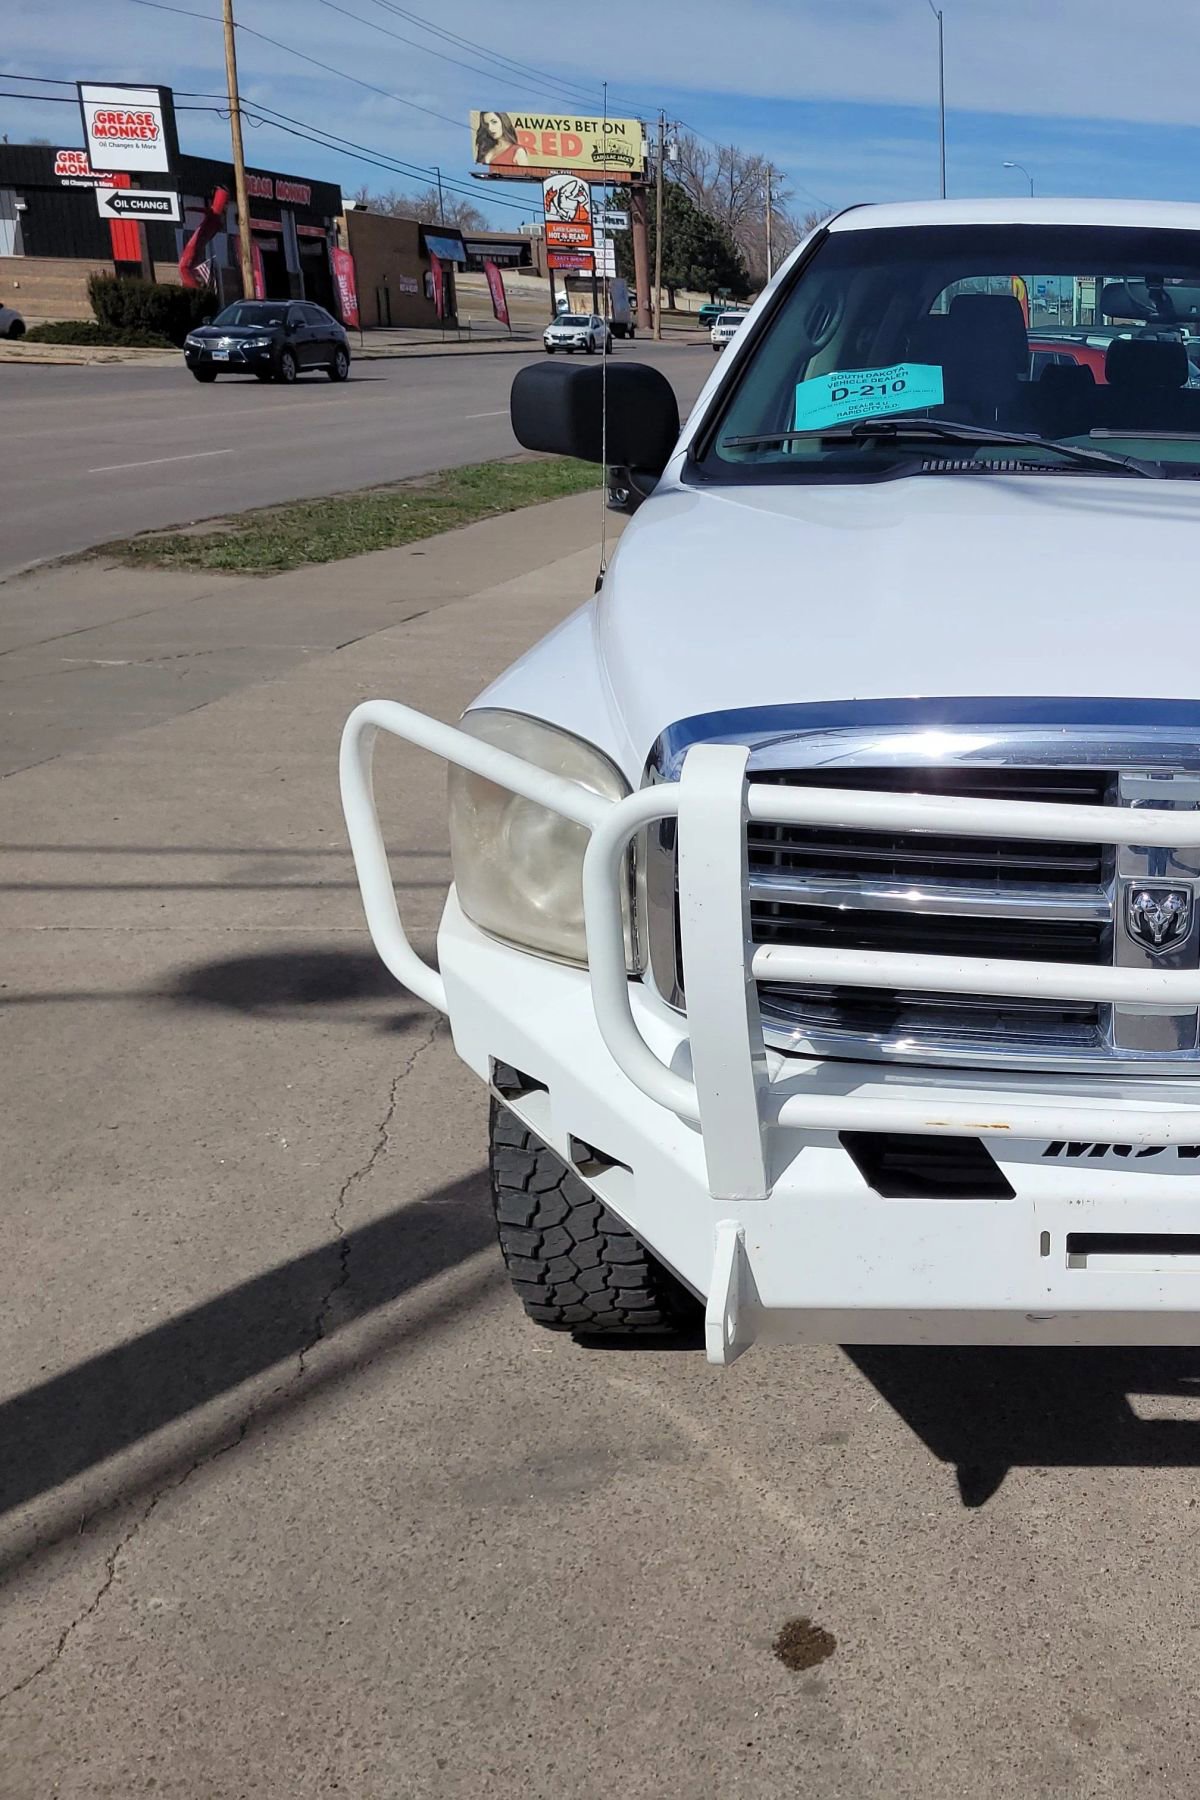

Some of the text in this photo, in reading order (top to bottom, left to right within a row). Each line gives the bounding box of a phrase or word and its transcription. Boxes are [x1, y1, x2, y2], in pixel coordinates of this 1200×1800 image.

[96, 111, 153, 126] GREASE
[514, 117, 626, 135] ALWAYS BET ON
[93, 124, 158, 139] MONKEY
[108, 142, 134, 150] Changes
[517, 130, 583, 158] RED
[58, 152, 88, 164] GRE
[55, 163, 89, 175] MON
[244, 174, 273, 199] REASE
[114, 200, 169, 210] OIL CHANGE
[827, 371, 909, 389] VEHICLE DEALER
[831, 366, 905, 382] SOUTH DAKOTA
[831, 379, 906, 402] D-210
[836, 408, 862, 417] RAPID
[848, 401, 875, 411] DEALS
